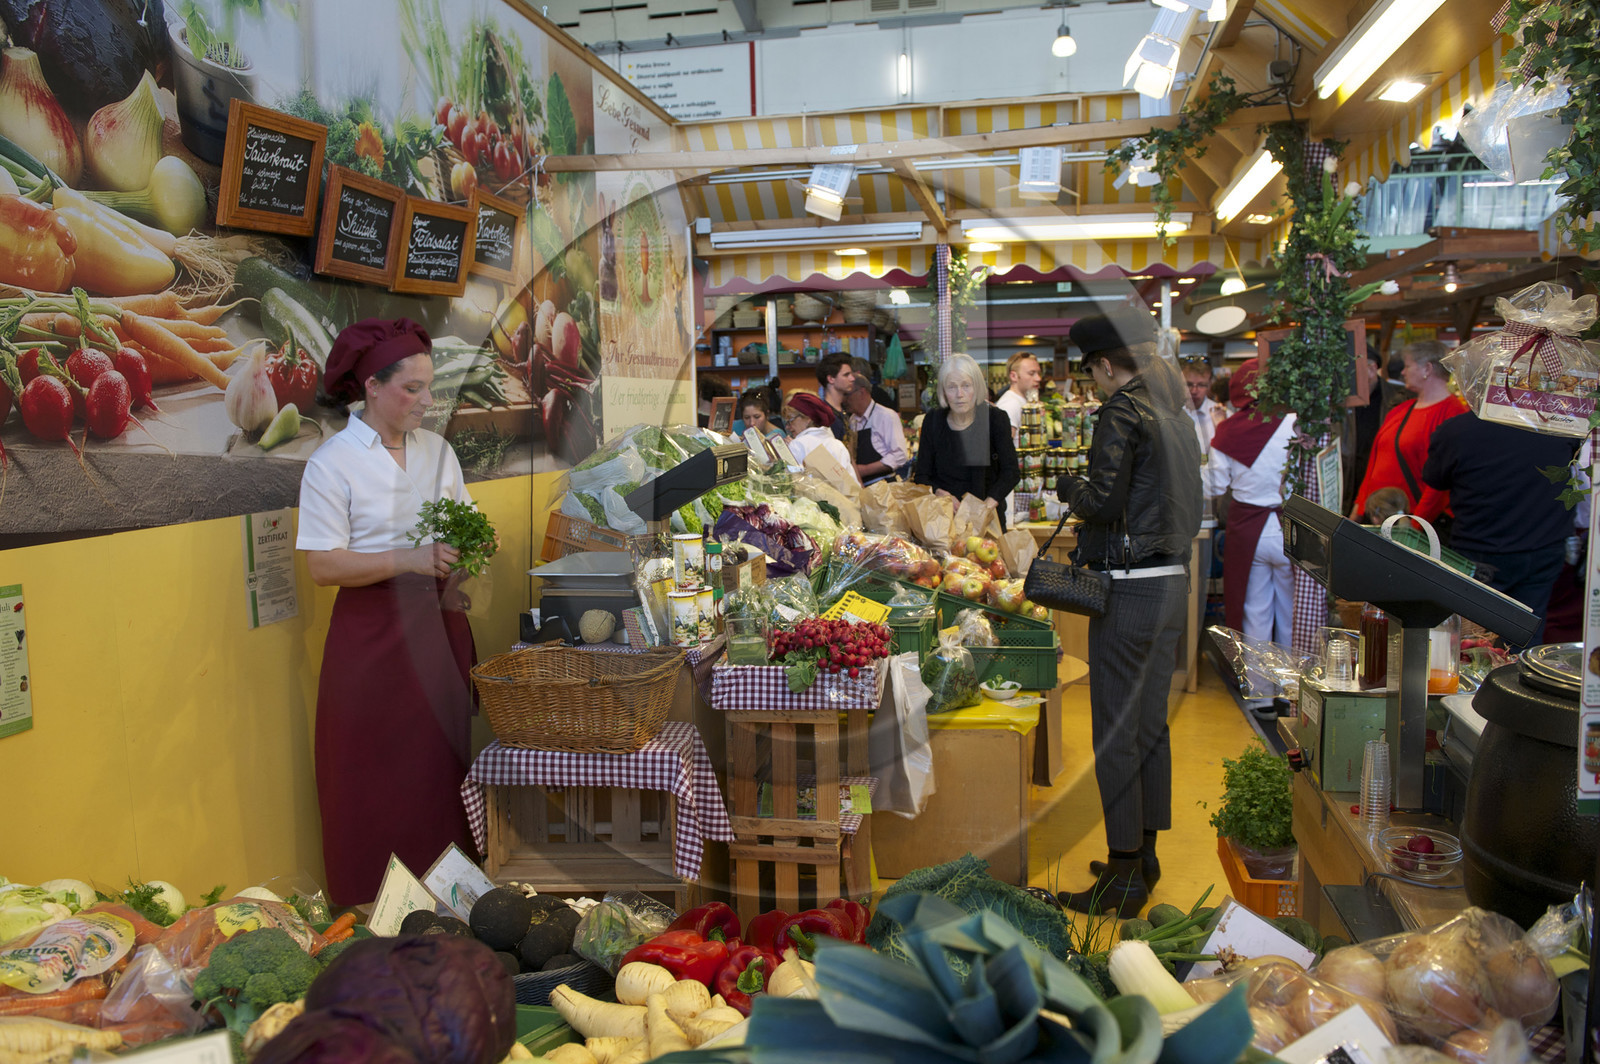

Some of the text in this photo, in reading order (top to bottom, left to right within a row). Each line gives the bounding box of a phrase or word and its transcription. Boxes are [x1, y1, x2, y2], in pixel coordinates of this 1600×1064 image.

[596, 84, 621, 122] Lebe
[621, 102, 650, 142] Gesund
[340, 210, 378, 239] Shiitake
[408, 227, 459, 251] Feldsalat
[606, 340, 624, 364] Ihr
[257, 531, 289, 545] ZERTIFIKAT
